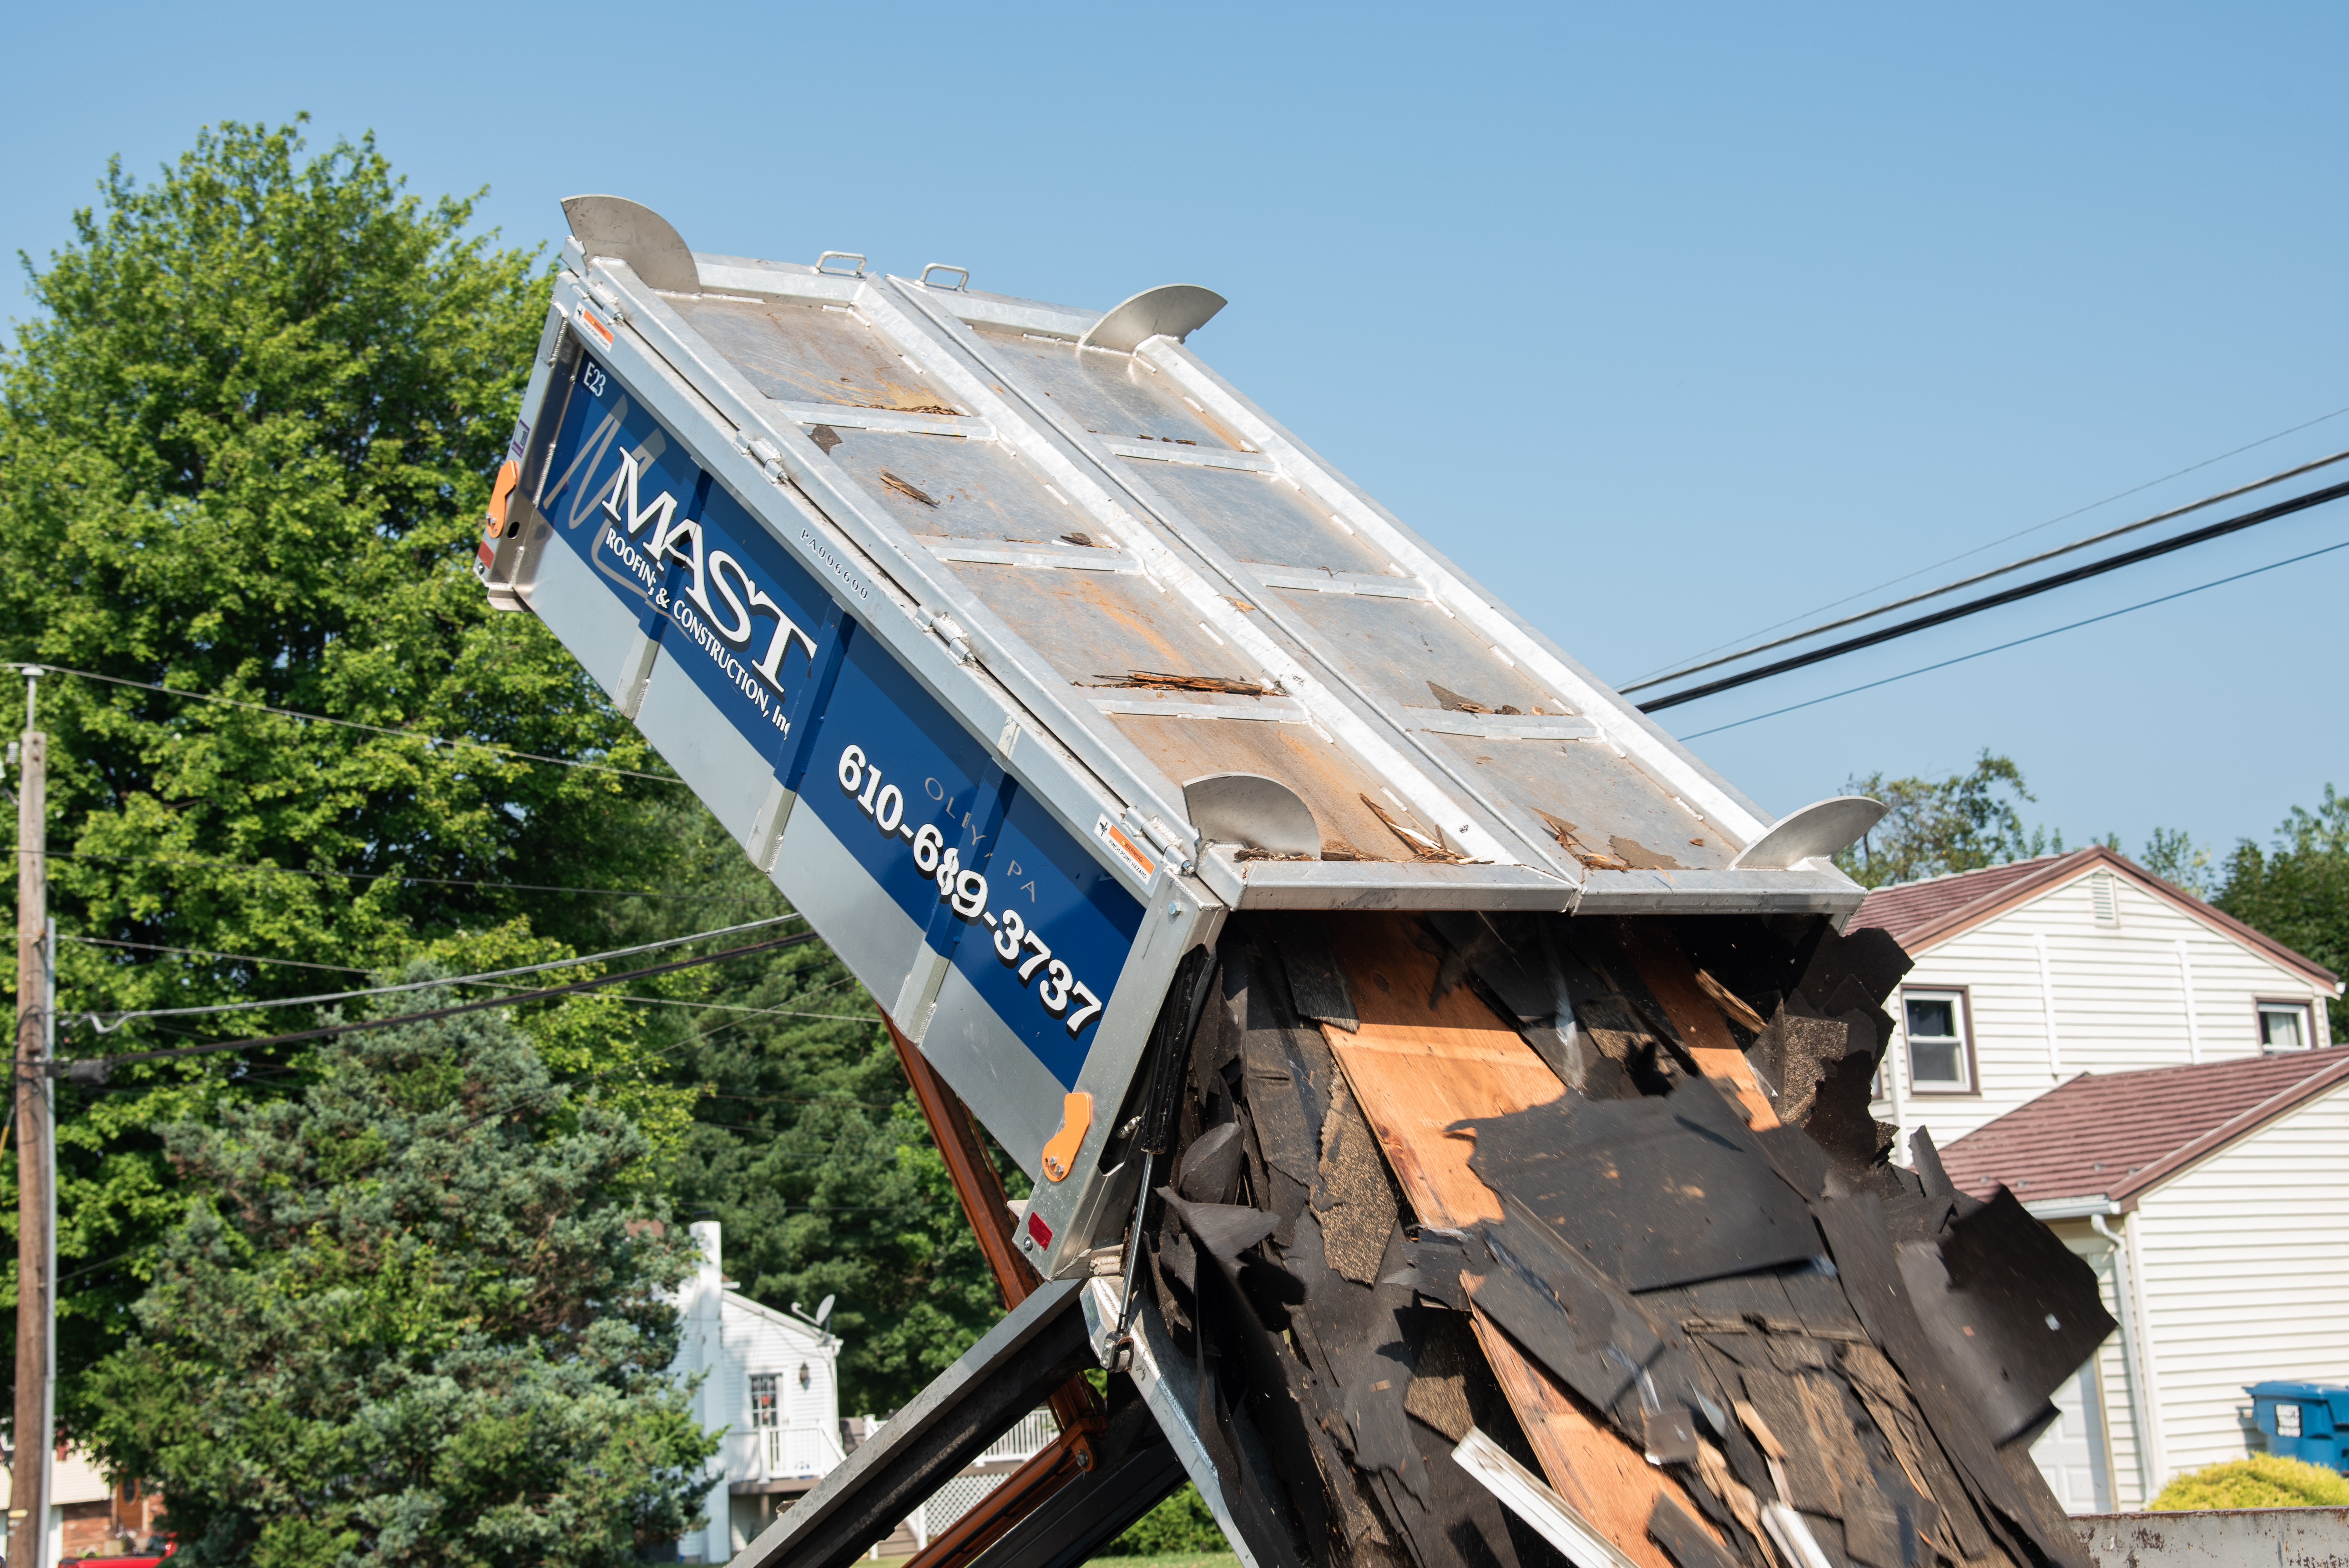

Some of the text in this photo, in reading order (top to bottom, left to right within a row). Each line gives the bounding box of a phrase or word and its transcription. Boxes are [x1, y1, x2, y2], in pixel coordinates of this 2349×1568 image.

[583, 361, 606, 397] E23
[602, 446, 818, 693] MAST
[800, 528, 868, 600] PA006600
[656, 587, 670, 609] &
[673, 600, 769, 718] CONSTRUCTION,
[1108, 839, 1147, 879] PINCH POINT HAZARD
[1125, 842, 1143, 862] WARNING
[838, 744, 1102, 1032] 610-689-3737
[1007, 860, 1035, 903] PA
